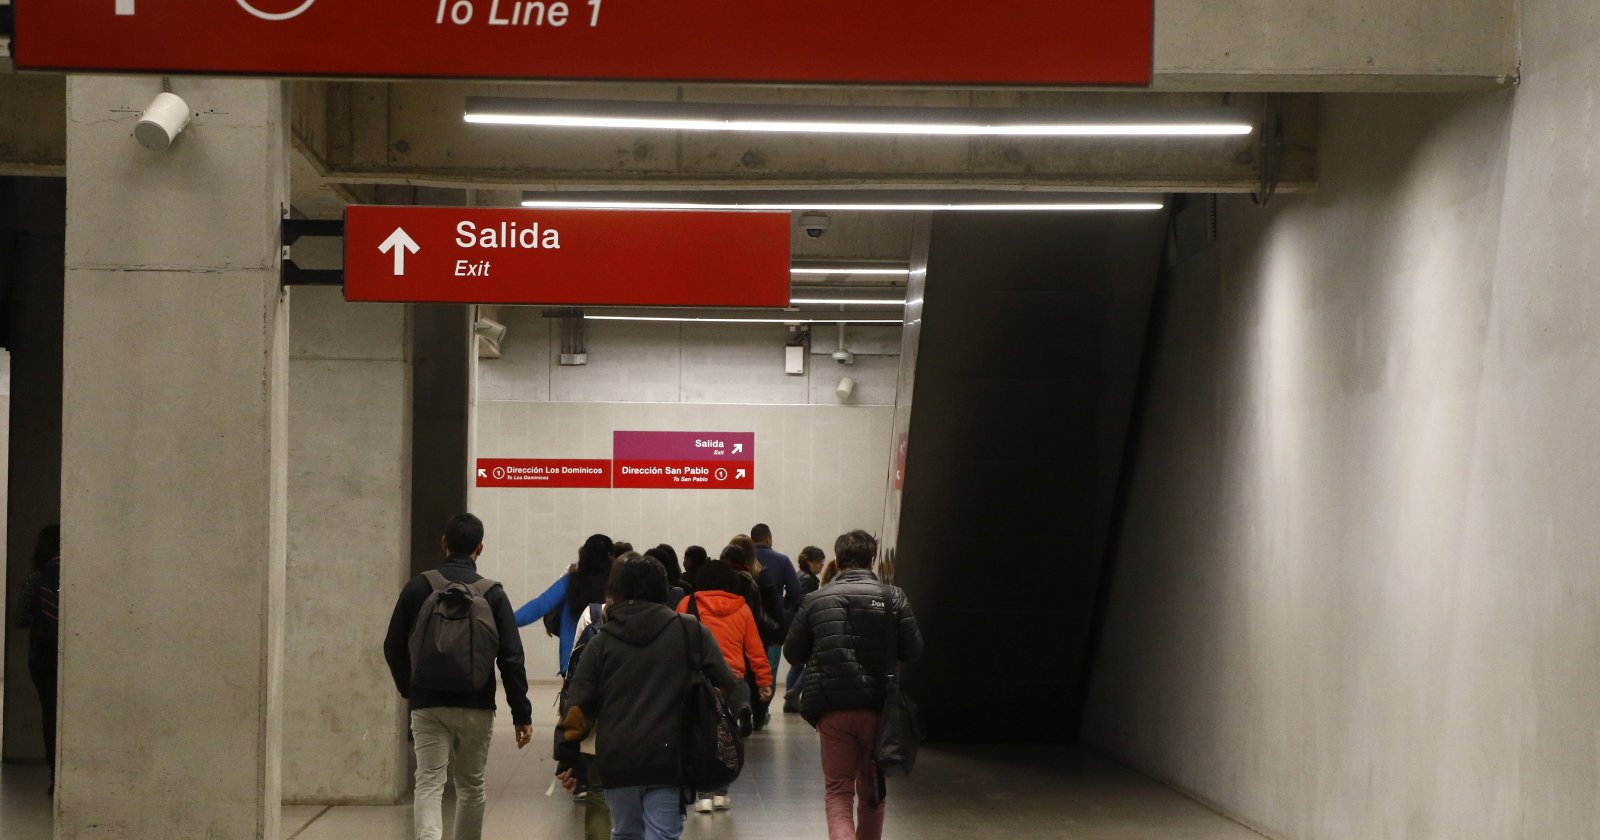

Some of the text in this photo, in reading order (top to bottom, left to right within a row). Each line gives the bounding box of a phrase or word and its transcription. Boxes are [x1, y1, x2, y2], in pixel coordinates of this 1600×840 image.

[488, 0, 569, 26] Line
[587, 0, 602, 27] 1
[455, 220, 561, 249] Salida
[454, 259, 491, 277] Exit
[695, 439, 725, 448] Salida
[506, 466, 544, 474] Dirección
[545, 466, 560, 474] Los
[621, 466, 663, 475] Dirección
[664, 466, 682, 475] San
[684, 466, 709, 475] Pablo
